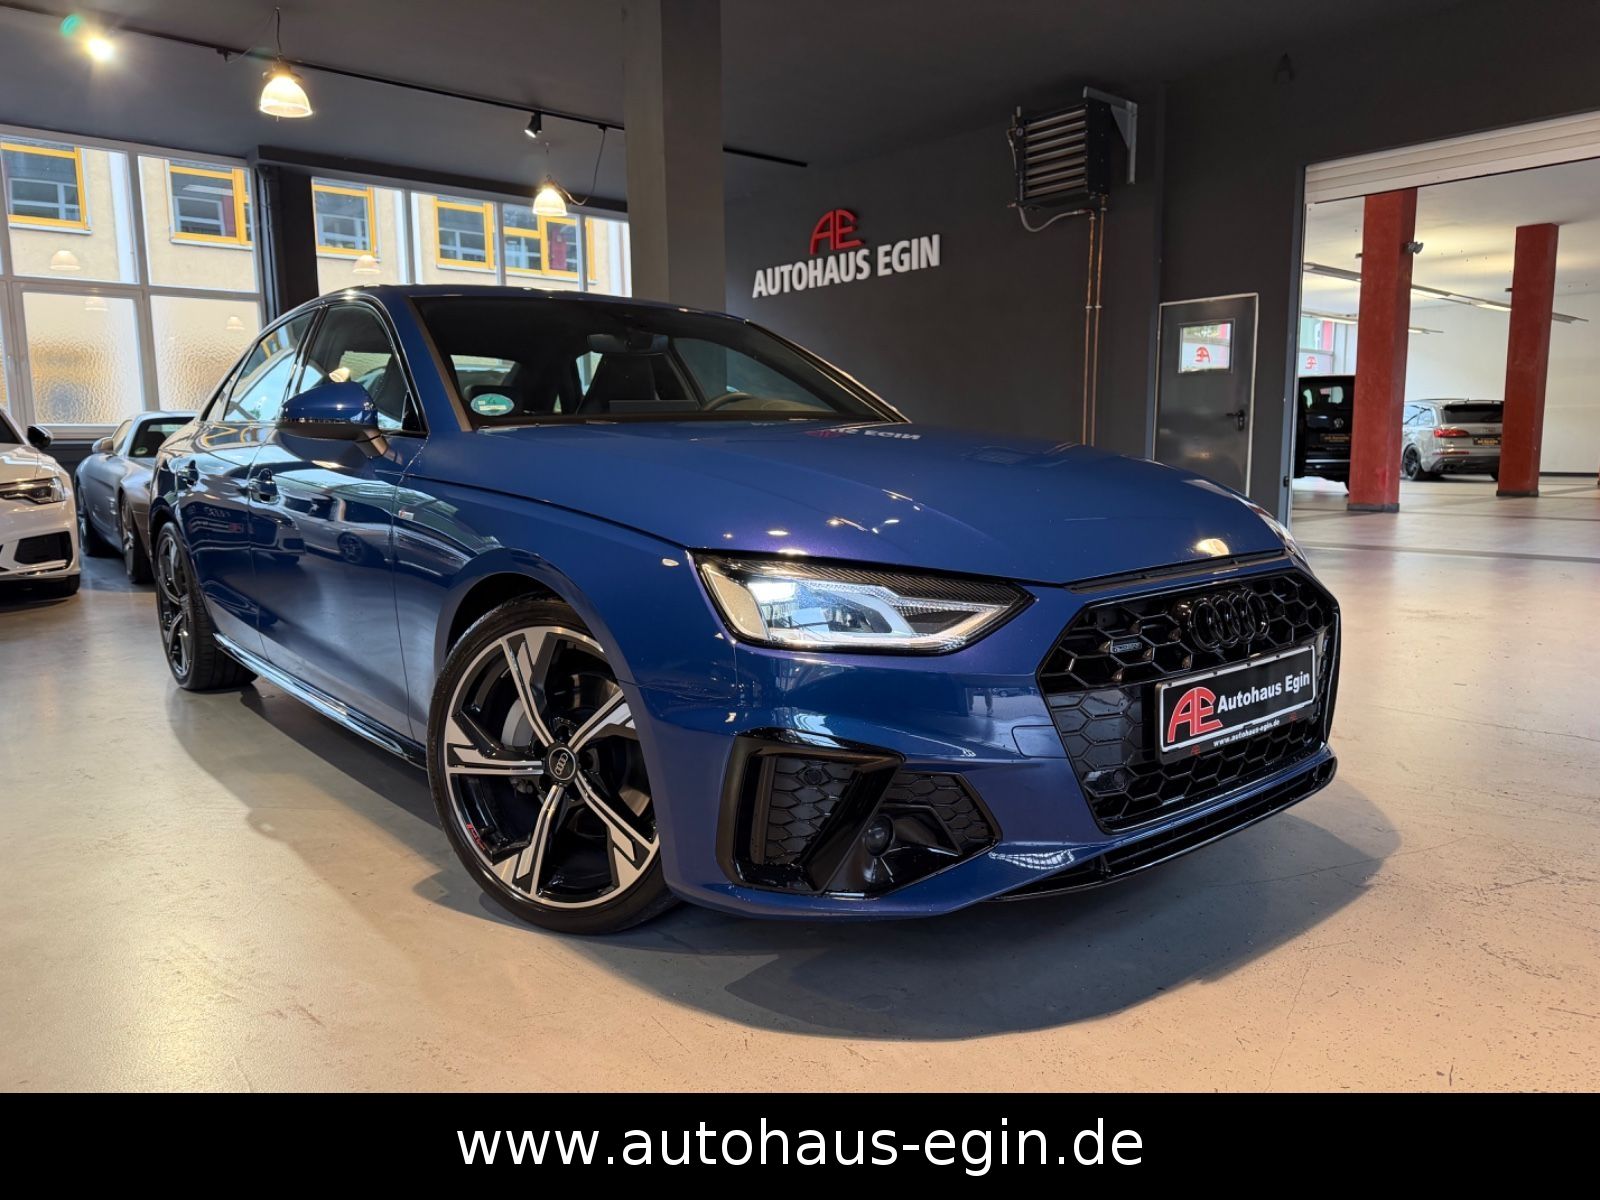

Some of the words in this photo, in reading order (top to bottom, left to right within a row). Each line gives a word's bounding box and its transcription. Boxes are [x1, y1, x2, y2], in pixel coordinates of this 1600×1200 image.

[752, 248, 871, 299] AUTOHAUS
[877, 233, 940, 277] EGIN
[1217, 683, 1282, 714] Autohaus
[1284, 671, 1311, 694] Egin
[1212, 718, 1280, 747] www.autohaus-egin.de
